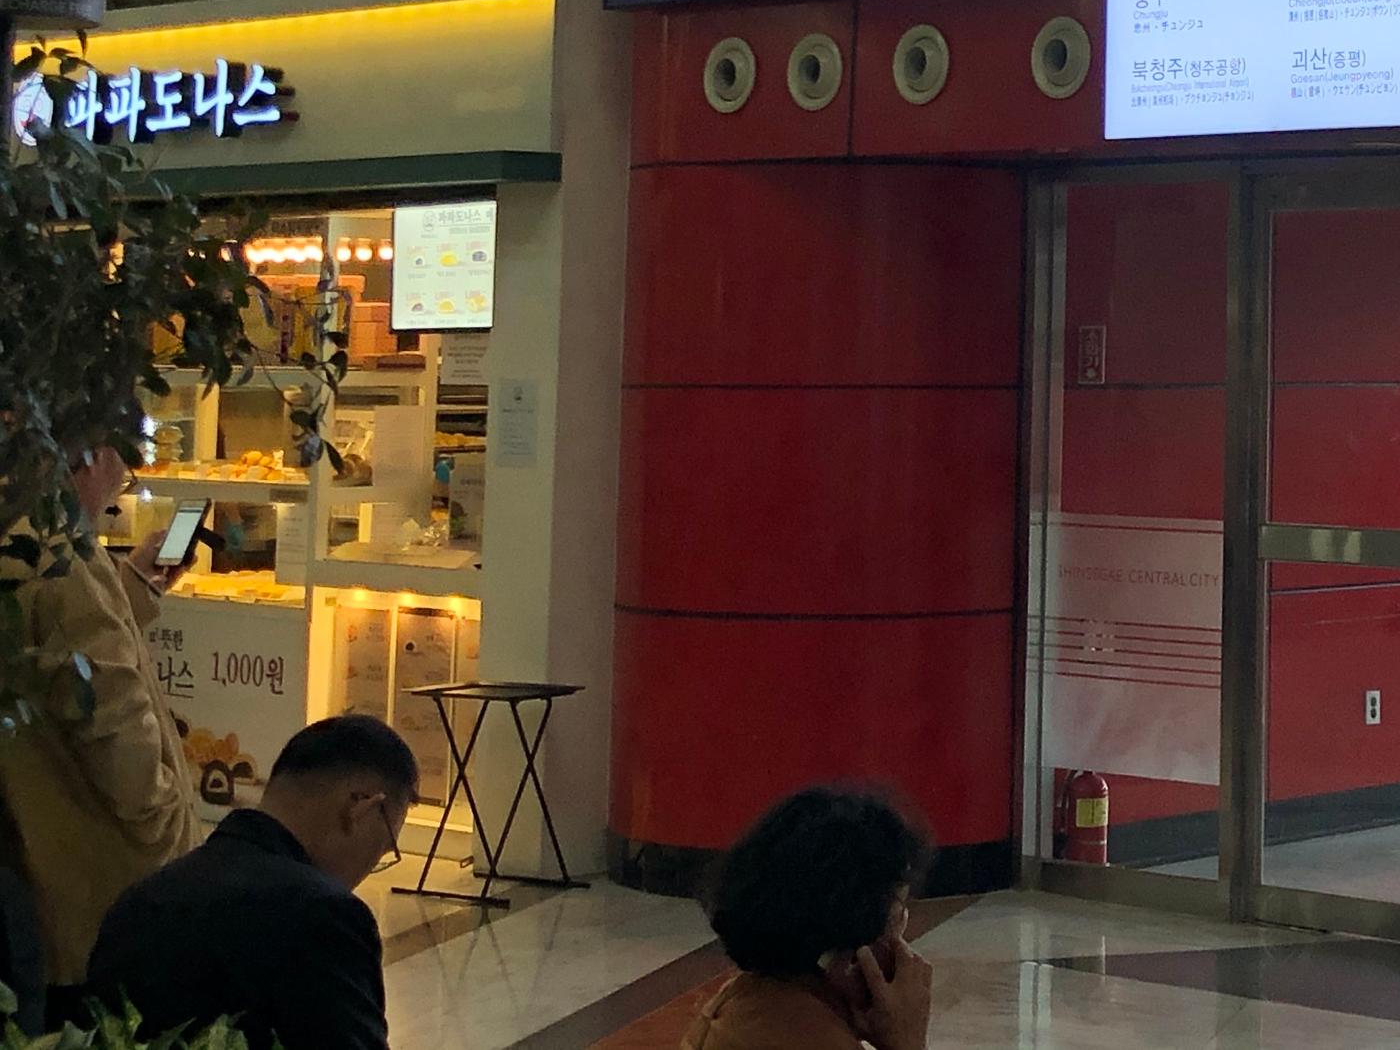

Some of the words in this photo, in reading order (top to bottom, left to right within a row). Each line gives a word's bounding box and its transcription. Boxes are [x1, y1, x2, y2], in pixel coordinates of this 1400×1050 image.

[1291, 47, 1366, 71] 괴산(증평)
[64, 57, 281, 142] 파파도나스
[1128, 569, 1186, 587] CENTRAL
[1189, 573, 1219, 587] CITY
[211, 651, 284, 695] 1,000원
